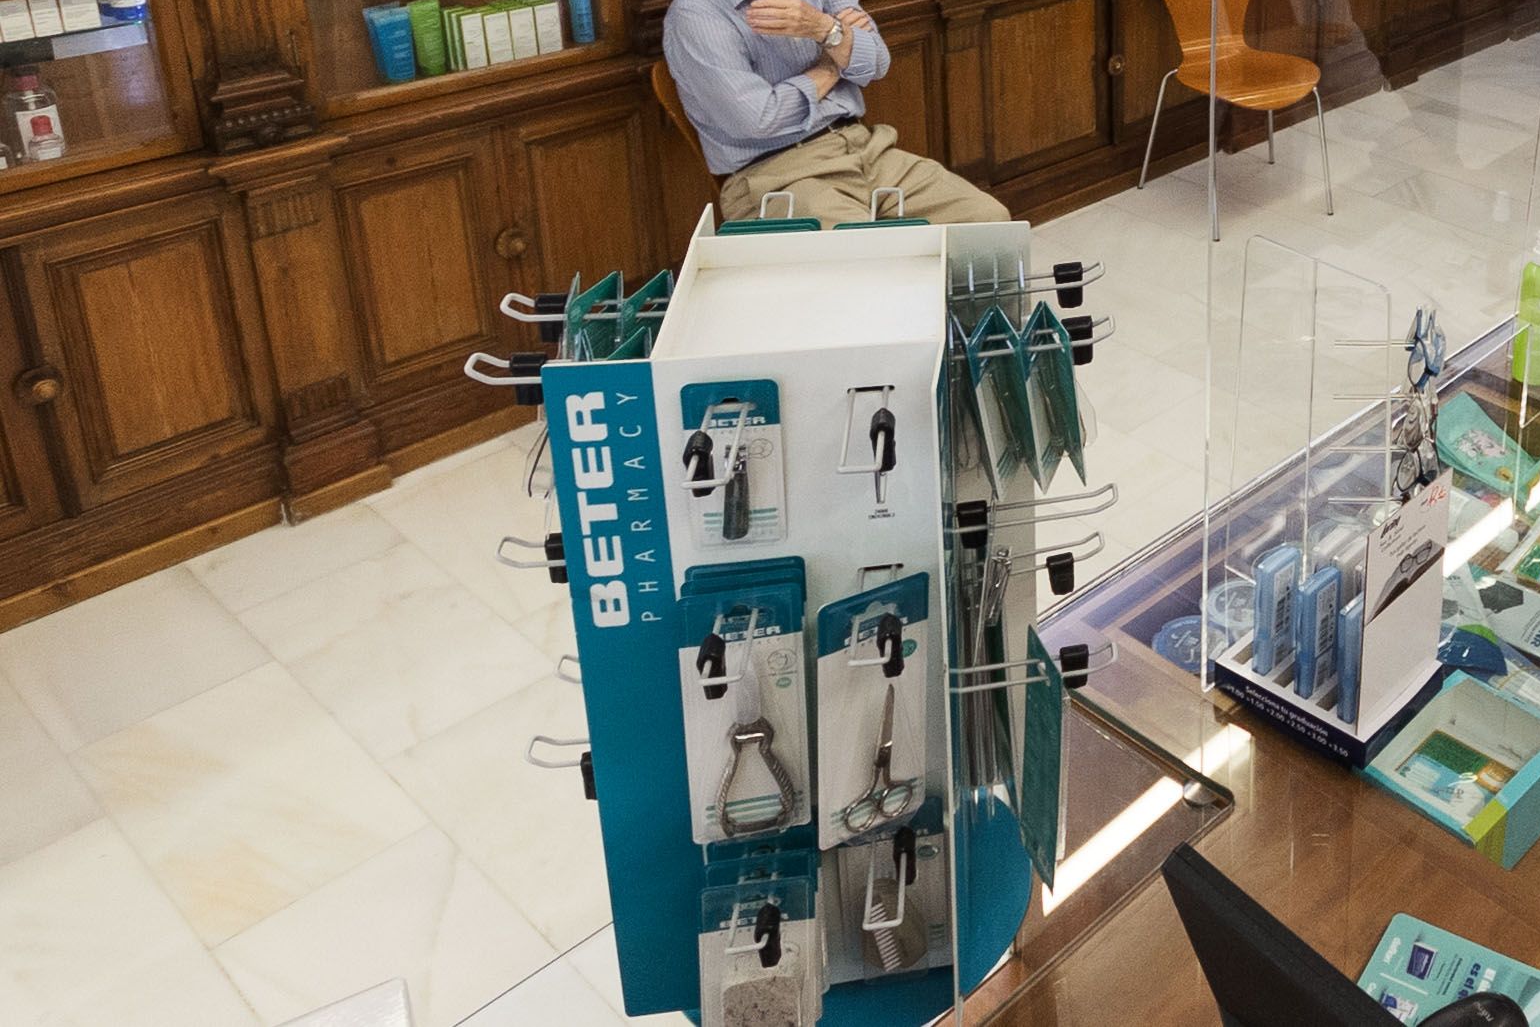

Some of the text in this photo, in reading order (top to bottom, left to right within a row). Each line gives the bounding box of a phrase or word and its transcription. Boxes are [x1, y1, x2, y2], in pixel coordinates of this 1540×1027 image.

[565, 391, 631, 628] BETER
[615, 392, 663, 622] PHARMACY
[1244, 685, 1329, 738] Selecciona tu graduación
[1266, 708, 1285, 722] +2.00
[1286, 719, 1306, 734] +2.50
[1307, 731, 1328, 746] +3.00
[1328, 742, 1349, 758] +3.50
